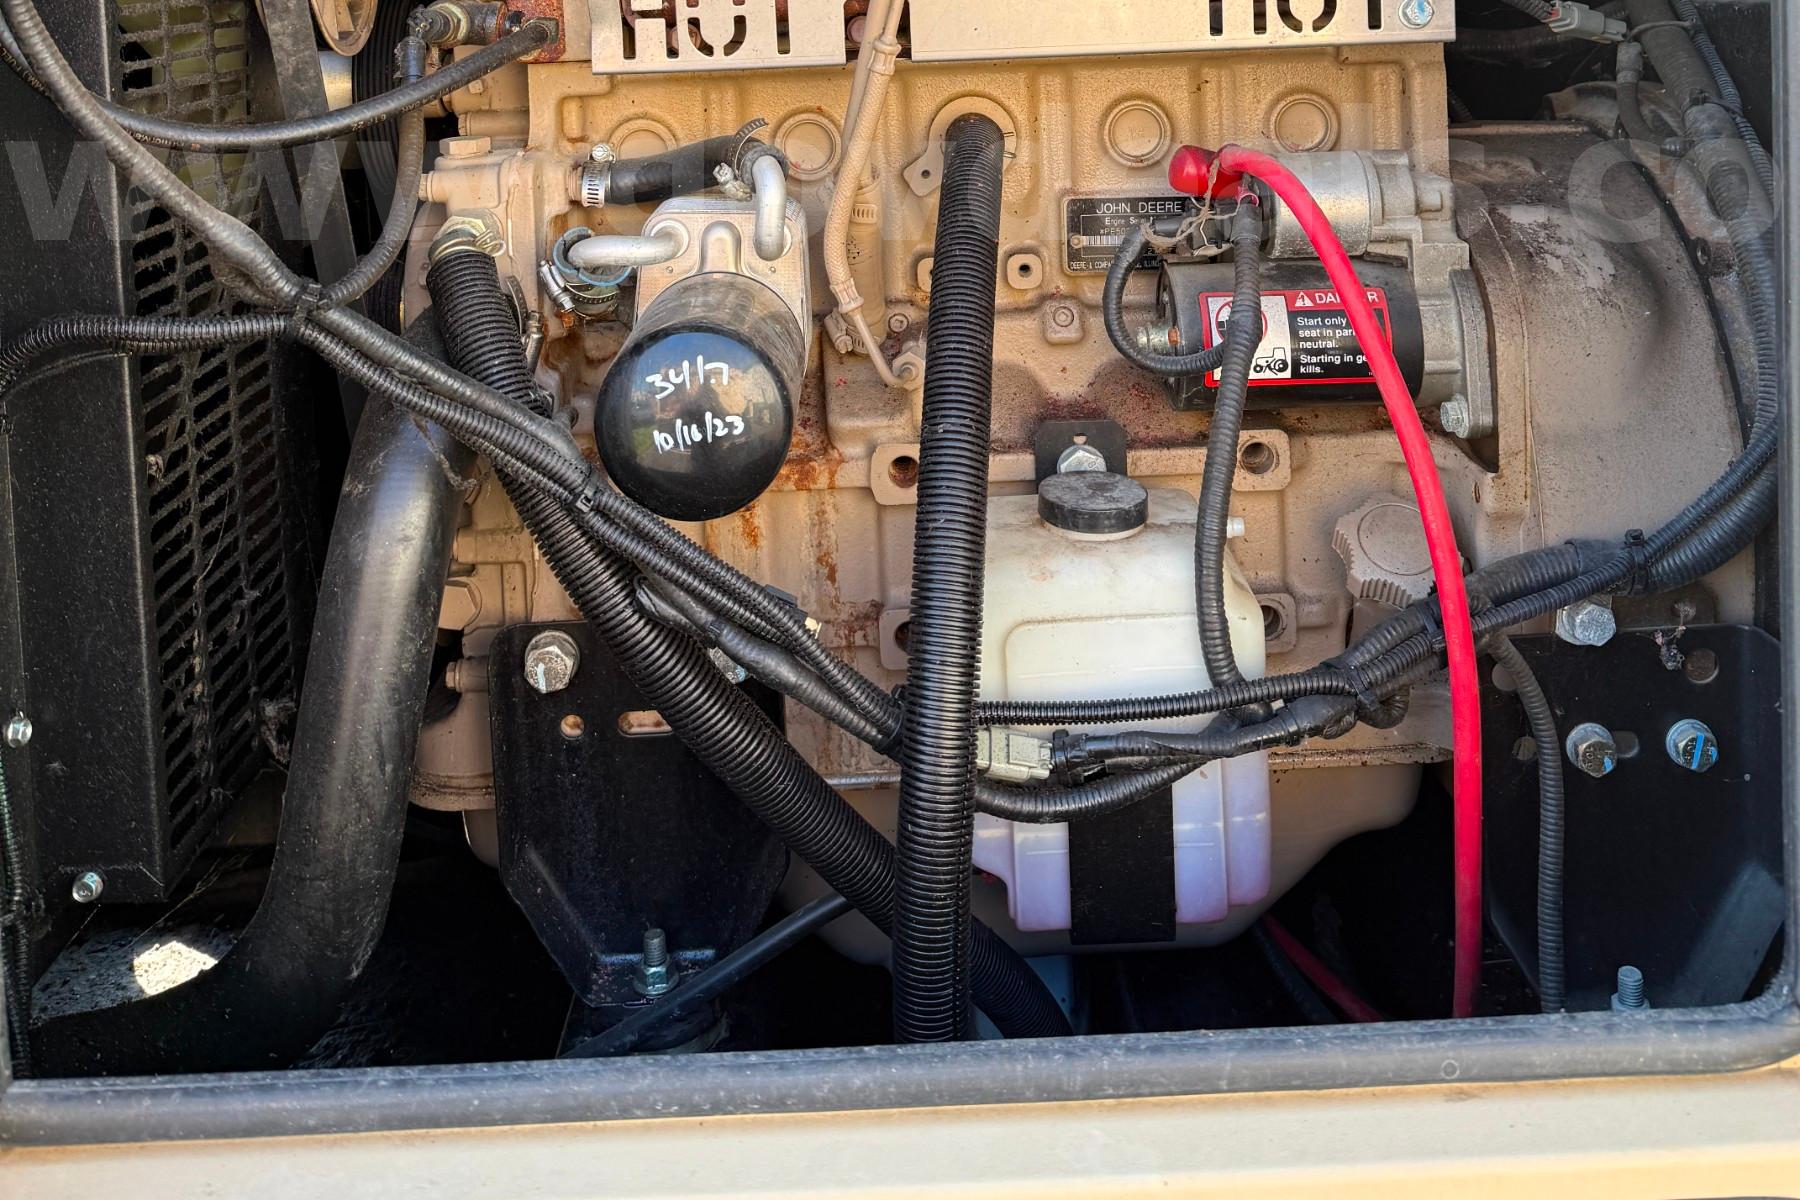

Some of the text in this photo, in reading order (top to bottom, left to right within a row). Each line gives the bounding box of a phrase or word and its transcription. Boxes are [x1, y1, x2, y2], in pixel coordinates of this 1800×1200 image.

[1096, 201, 1183, 214] JOHN DEERE
[1296, 316, 1347, 327] Start only
[1298, 329, 1321, 338] seat
[1323, 328, 1333, 337] in
[1299, 340, 1339, 348] neutral.
[1299, 354, 1341, 364] Starting
[1343, 353, 1354, 362] in
[1299, 365, 1325, 374] kills.
